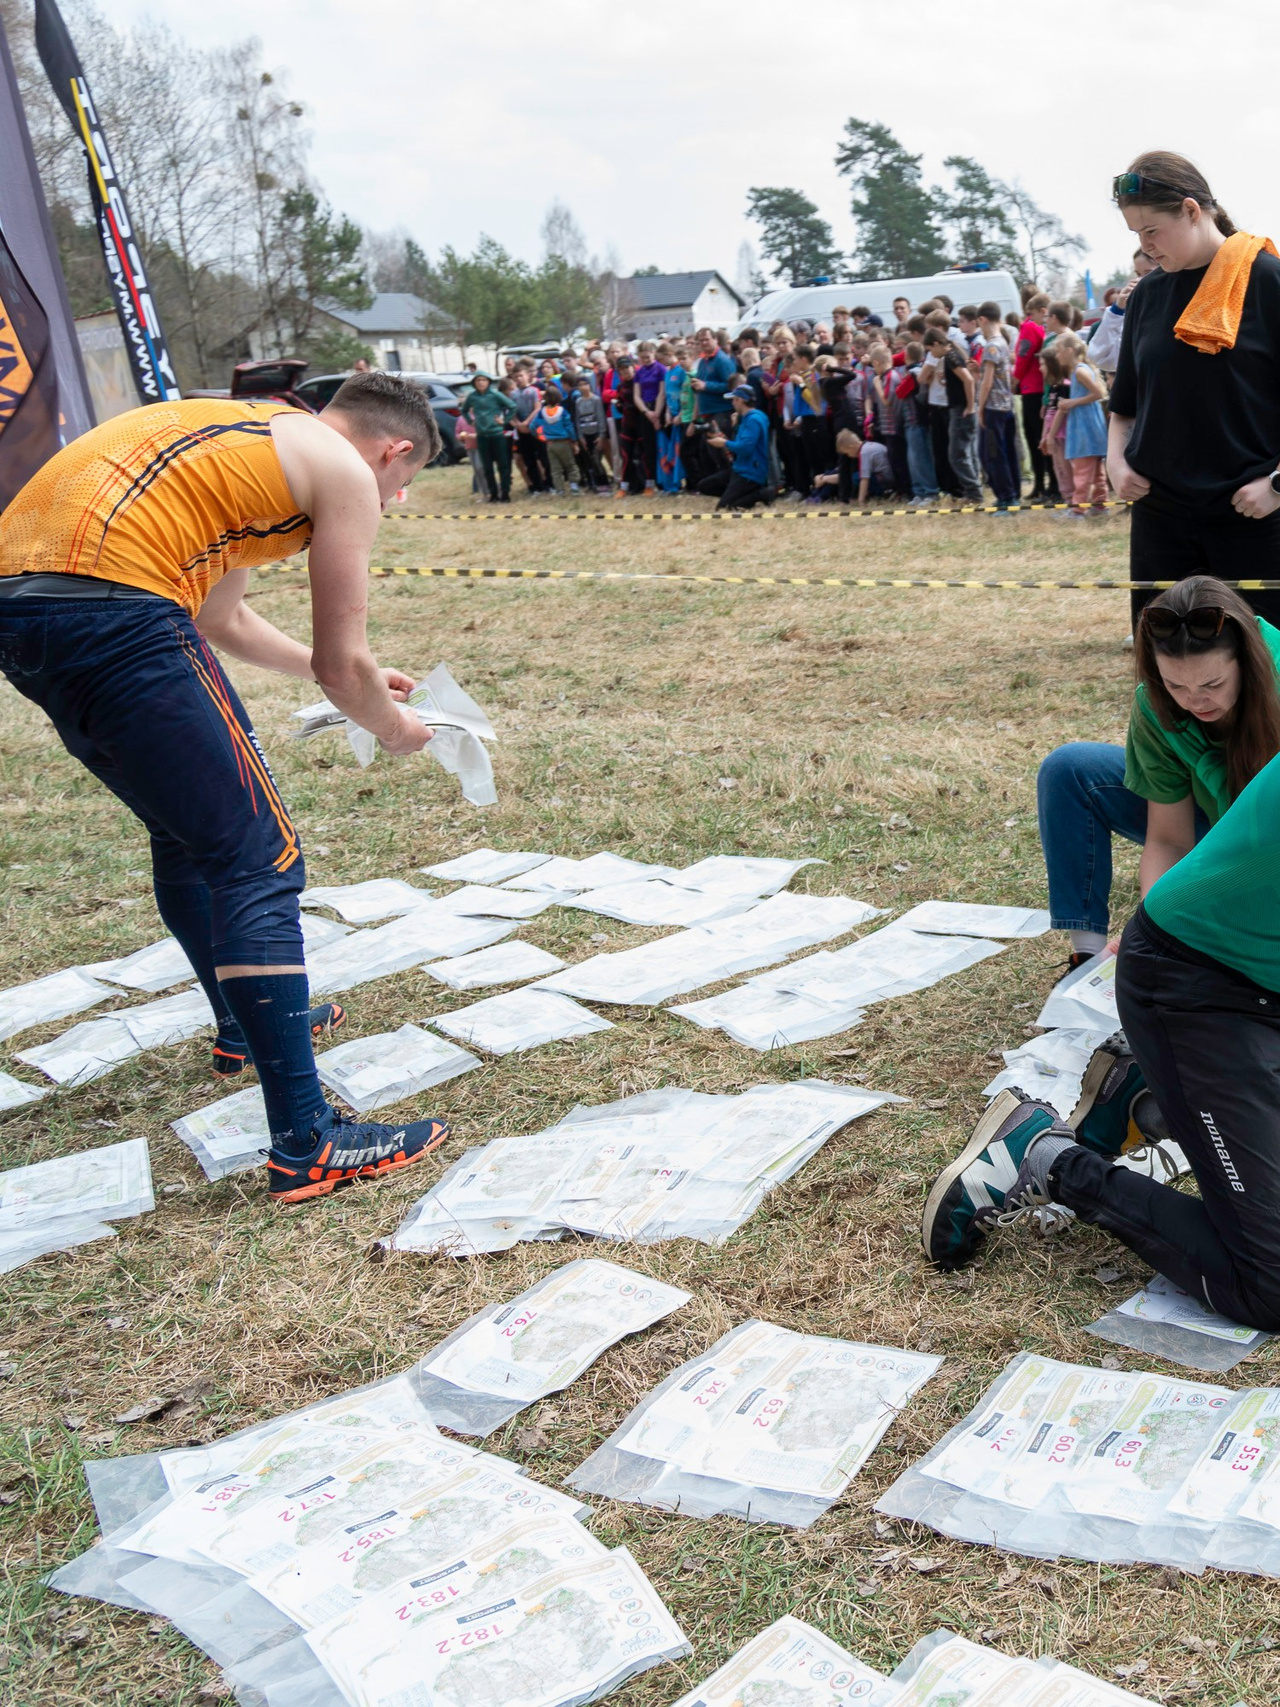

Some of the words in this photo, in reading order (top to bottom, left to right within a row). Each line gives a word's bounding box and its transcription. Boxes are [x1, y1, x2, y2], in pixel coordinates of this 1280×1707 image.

[1200, 1110, 1245, 1193] noname
[501, 1310, 537, 1338] 76.2
[752, 1398, 784, 1428] 63.2
[1047, 1434, 1075, 1464] 60.2
[1114, 1439, 1143, 1469] 60.3
[1230, 1444, 1261, 1473] 55.3
[277, 1491, 337, 1524] 187.2
[338, 1527, 397, 1563] 185.2
[395, 1585, 461, 1621] 183.2
[435, 1623, 504, 1655] 182.2
